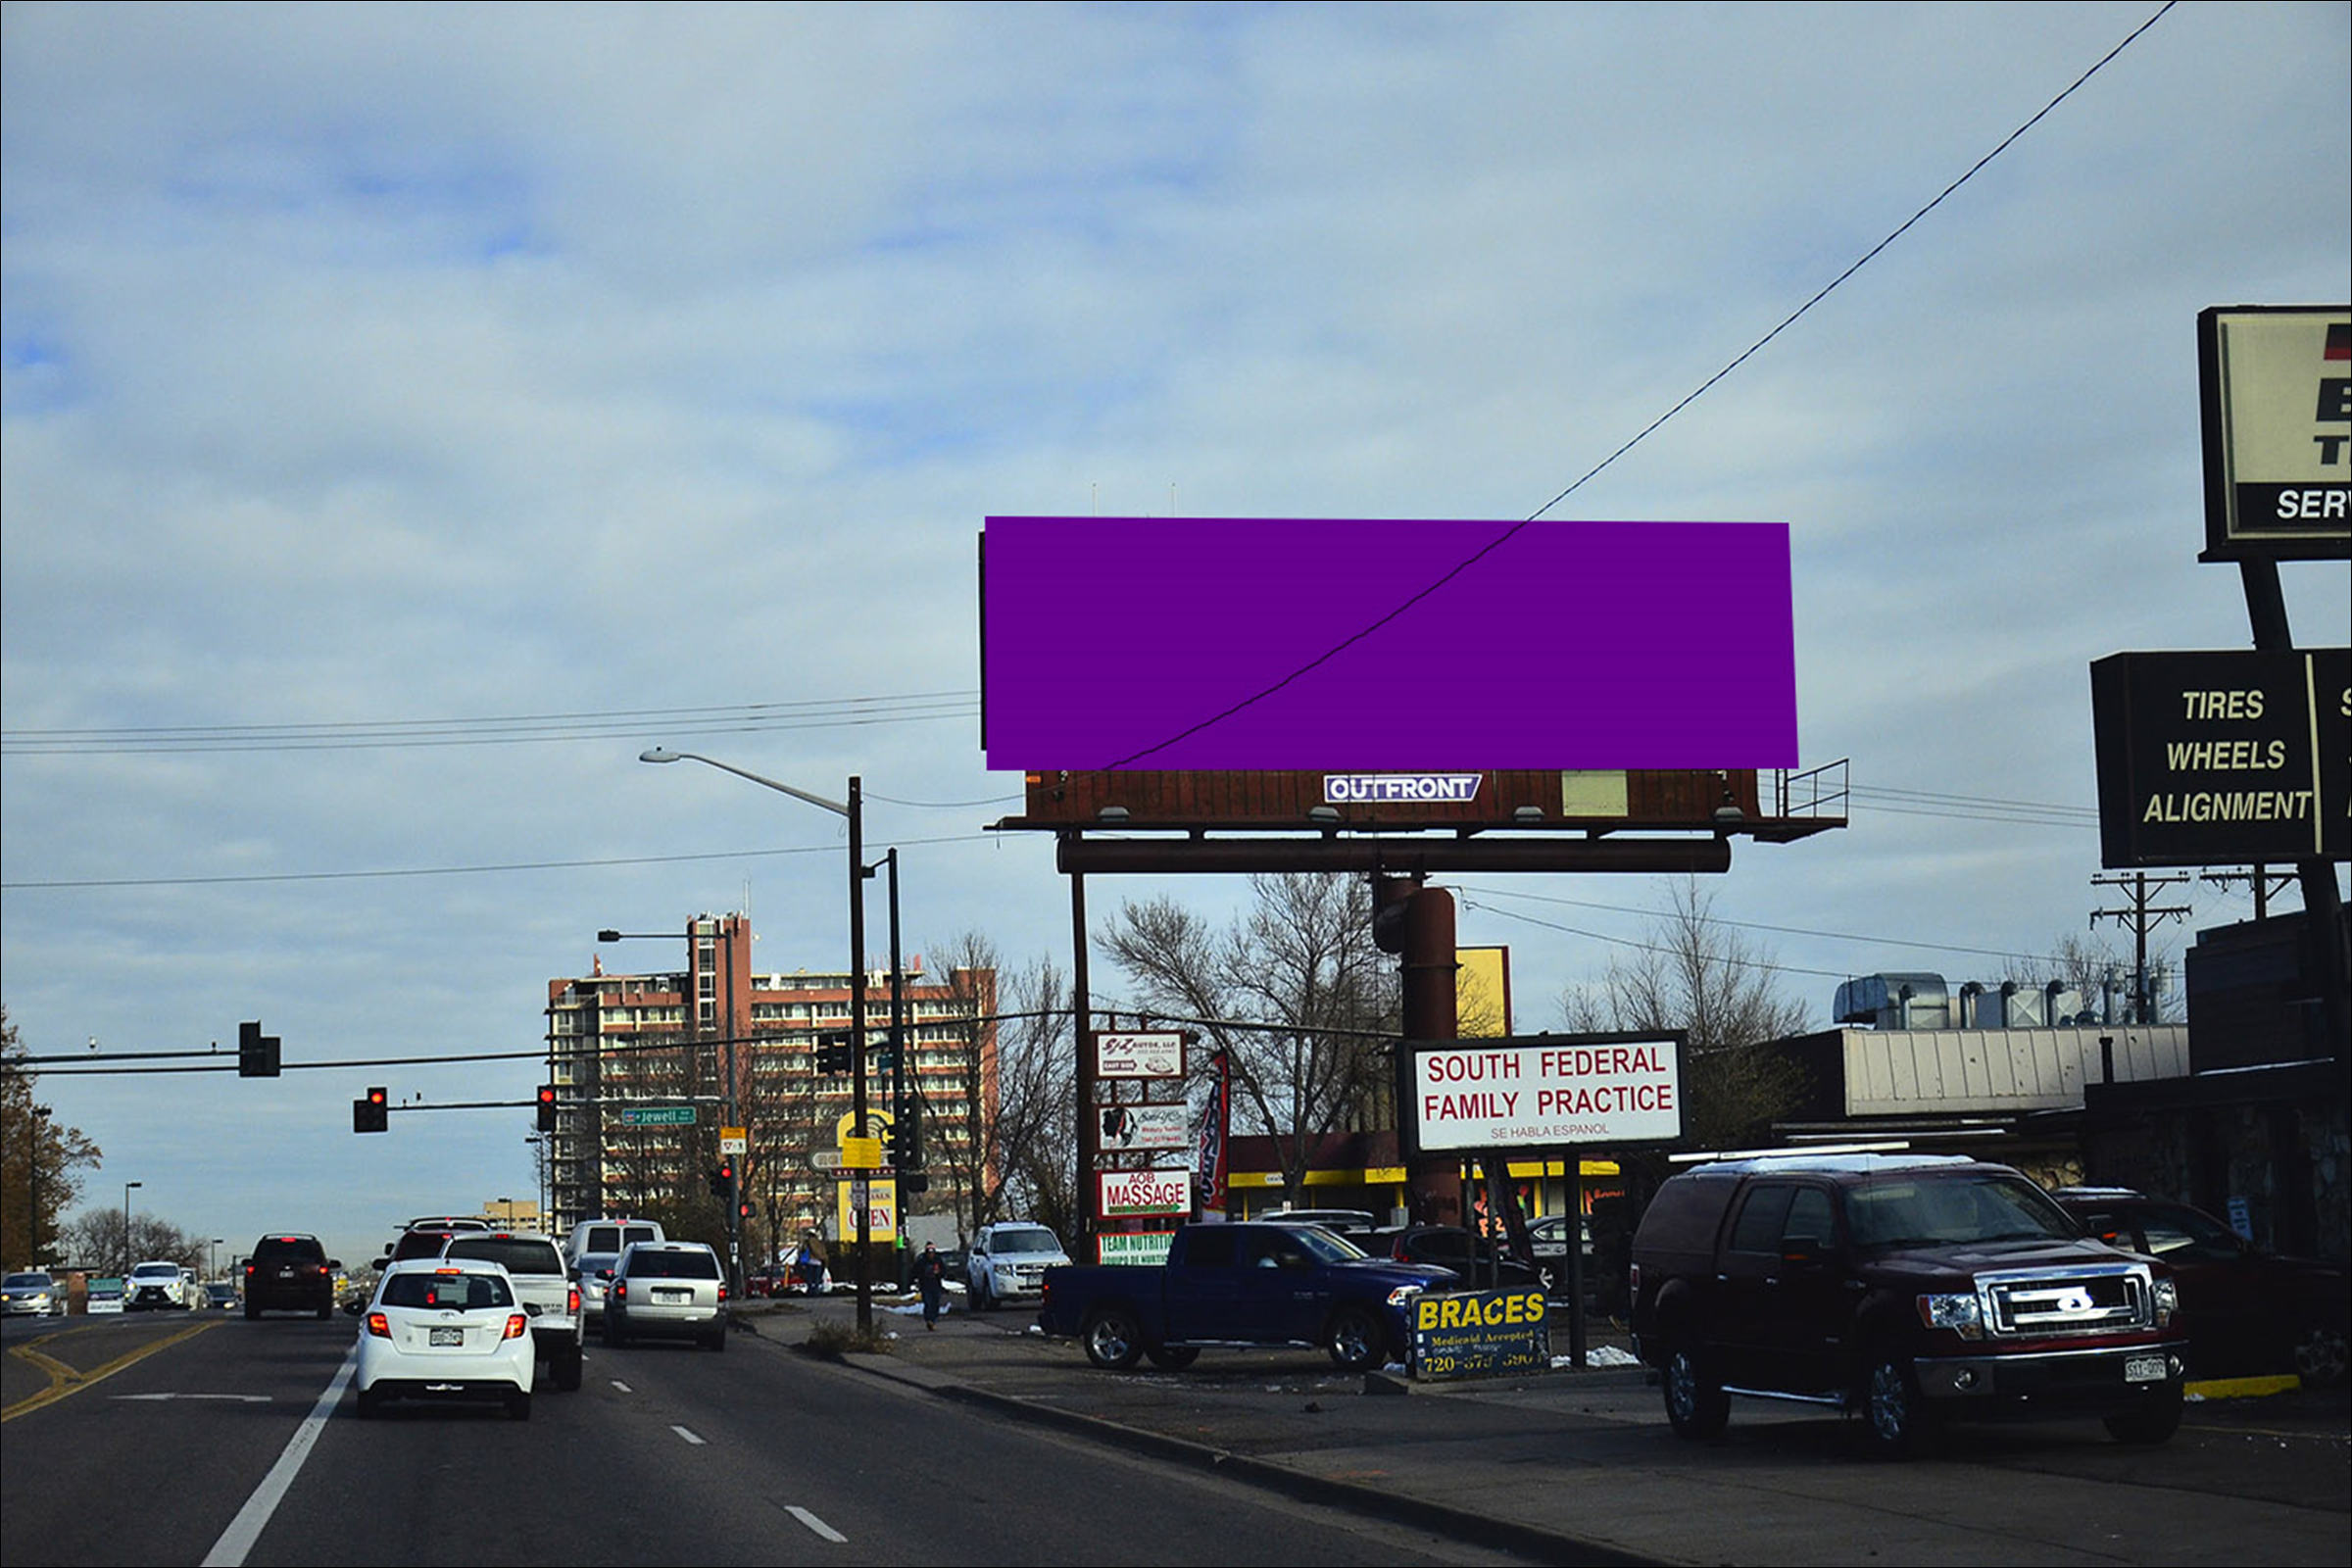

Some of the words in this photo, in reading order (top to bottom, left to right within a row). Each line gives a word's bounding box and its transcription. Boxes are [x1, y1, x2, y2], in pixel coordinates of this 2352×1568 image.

[2277, 490, 2351, 518] SER
[2182, 691, 2264, 720] TIRES
[2167, 740, 2285, 770] WHEELS
[1330, 778, 1472, 799] OUTFRONT
[2143, 791, 2313, 823] ALIGNMENT
[1428, 1054, 1520, 1082] SOUTH
[1542, 1047, 1666, 1077] FEDERAL
[1425, 1092, 1519, 1120] FAMILY
[1538, 1085, 1672, 1115] PRACTICE
[642, 1110, 676, 1122] Jewell
[1491, 1128, 1507, 1140] SE
[1510, 1126, 1551, 1138] HABLA
[1553, 1123, 1609, 1136] ESPANOL
[1107, 1183, 1185, 1205] MASSAGE
[849, 1208, 890, 1227] OEN
[1102, 1236, 1127, 1251] TEAM
[1418, 1293, 1544, 1330] BRACES
[1432, 1334, 1480, 1347] Medicaid
[1485, 1330, 1534, 1343] Accepted
